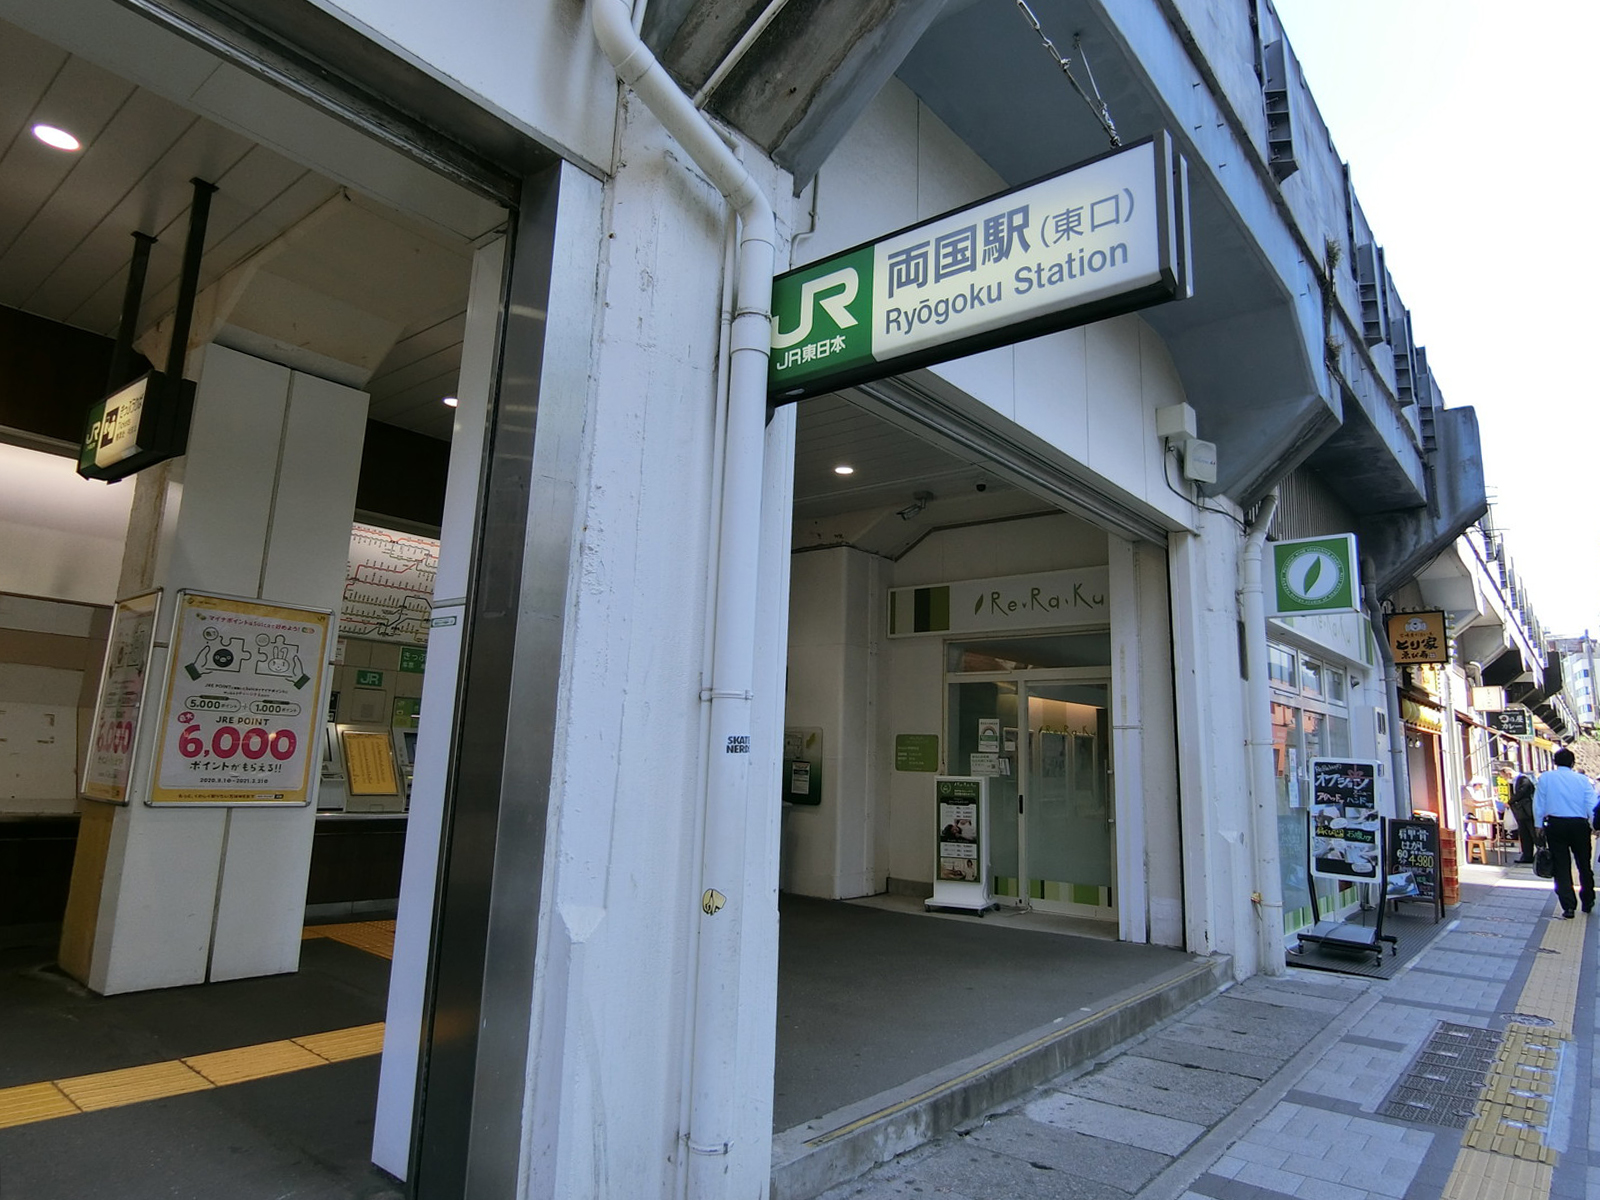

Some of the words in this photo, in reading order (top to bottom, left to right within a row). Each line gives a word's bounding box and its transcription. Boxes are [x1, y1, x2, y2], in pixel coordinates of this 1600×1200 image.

[887, 204, 1031, 299] 両国駅
[1040, 187, 1135, 248] (東口)
[885, 281, 1002, 335] Ryōgoku
[1014, 240, 1128, 296] Station
[772, 266, 860, 350] JR
[776, 334, 847, 370] JR東日本
[85, 420, 101, 445] JR
[360, 673, 379, 685] JR
[215, 715, 235, 724] JRE
[237, 716, 270, 726] POINT
[178, 724, 298, 761] 6,000
[726, 745, 751, 754] NERD
[1396, 849, 1409, 858] 60
